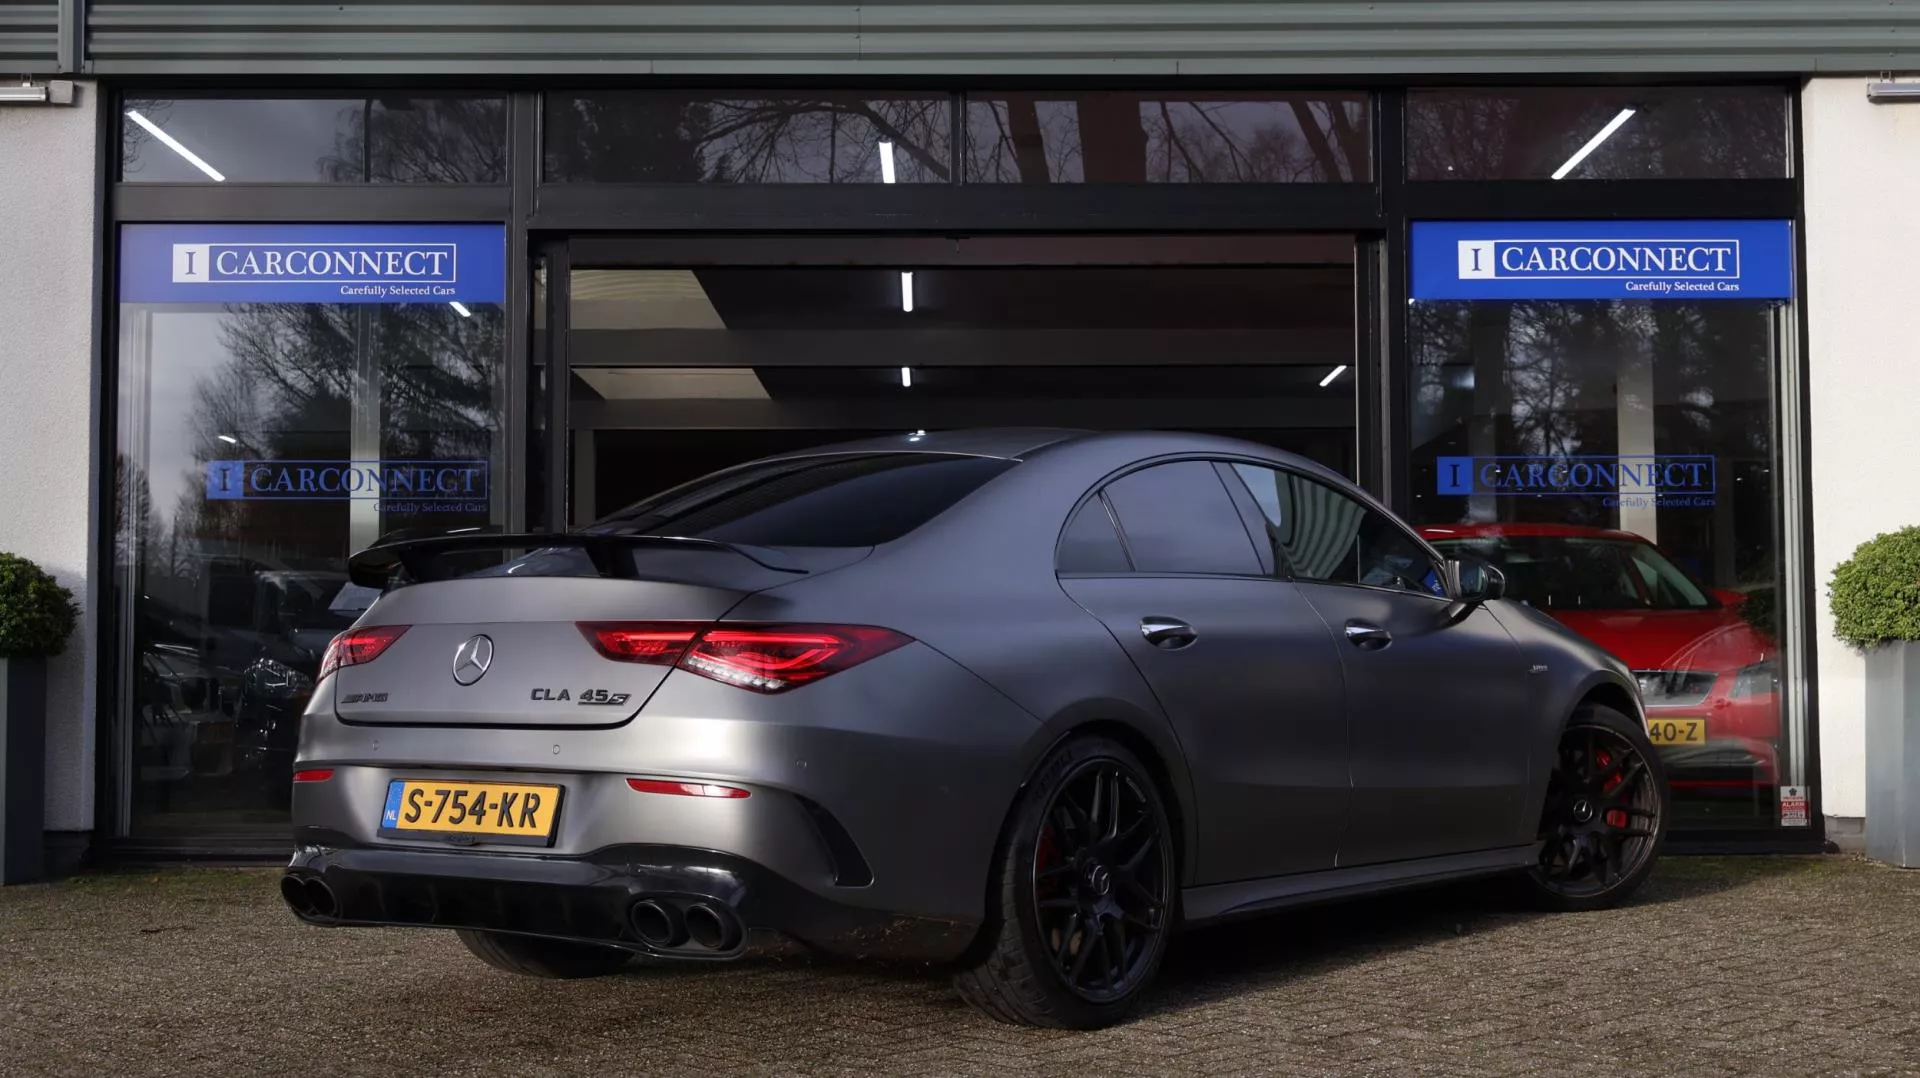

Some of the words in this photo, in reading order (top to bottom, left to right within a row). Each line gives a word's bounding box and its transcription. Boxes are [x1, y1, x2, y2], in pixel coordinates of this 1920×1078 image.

[216, 250, 447, 276] CARCONNECT
[1502, 247, 1731, 272] CARCONNECT
[340, 285, 387, 298] Carefully
[389, 285, 430, 296] Selected
[433, 286, 456, 295] Cars
[1625, 281, 1672, 293] Carefully
[1674, 281, 1714, 292] Selected
[1717, 282, 1739, 291] Cars
[251, 468, 479, 492] CARCONNECT
[1480, 463, 1706, 488] CARCONNECT
[374, 502, 420, 514] Carefully
[422, 502, 462, 512] Selected
[465, 502, 487, 512] Cars
[1603, 498, 1648, 510] Carefully
[1651, 497, 1691, 508] Selected
[1693, 498, 1716, 508] Cars
[530, 688, 571, 701] CLA
[404, 788, 541, 828] S-754-KR
[385, 810, 397, 821] NL
